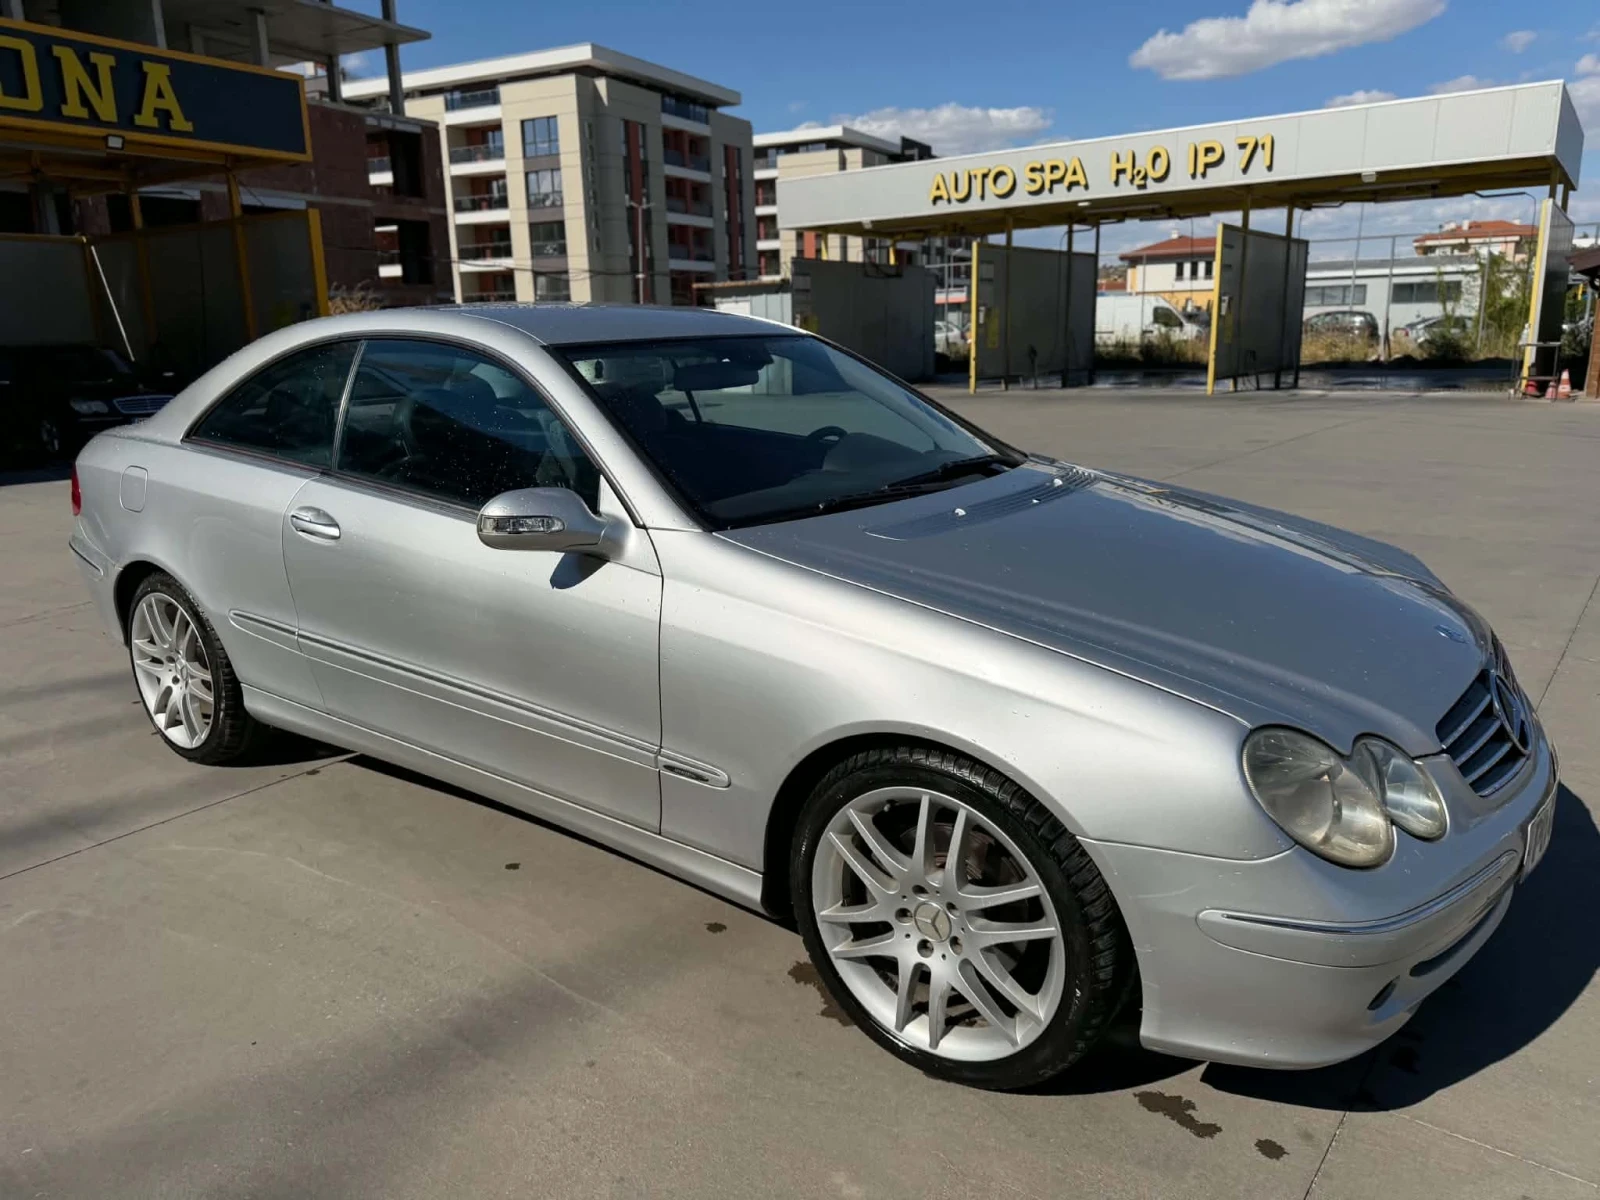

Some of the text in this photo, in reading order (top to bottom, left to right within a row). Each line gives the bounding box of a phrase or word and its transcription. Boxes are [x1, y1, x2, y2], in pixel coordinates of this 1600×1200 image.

[930, 165, 1015, 205] AUTO
[1024, 157, 1088, 194] SPA
[1187, 140, 1225, 178] IP
[1235, 133, 1274, 171] 71
